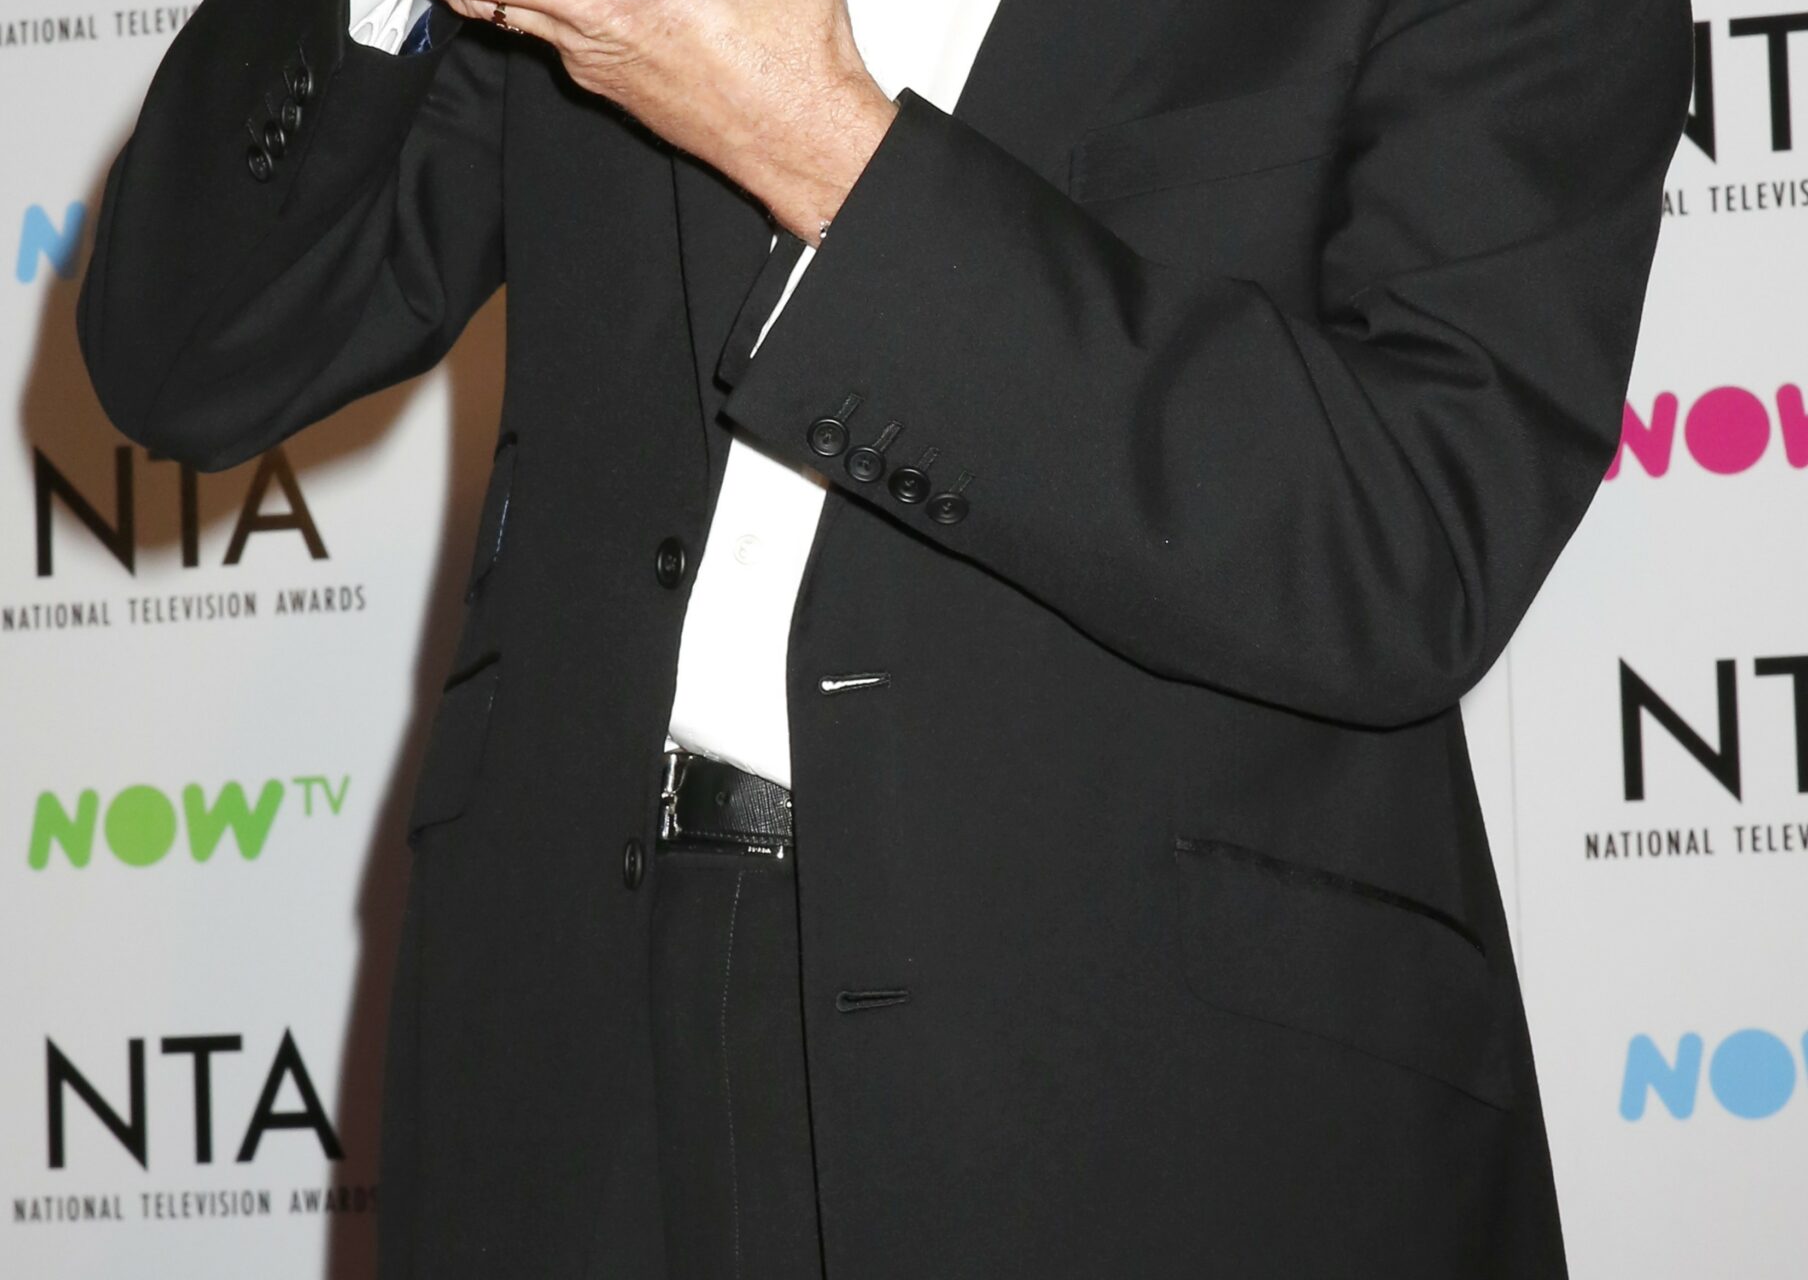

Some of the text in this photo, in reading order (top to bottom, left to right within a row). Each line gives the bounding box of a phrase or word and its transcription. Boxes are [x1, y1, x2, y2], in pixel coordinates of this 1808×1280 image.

[0, 5, 200, 47] ATIONAL TELEVI
[33, 444, 329, 578] NTA
[2, 584, 366, 631] NATIONAL TELEVISION AWARDS
[27, 775, 350, 871] NOW TV
[1585, 828, 1714, 860] NATIONAL
[45, 1025, 345, 1172] NTA
[1618, 1027, 1808, 1122] NO
[13, 1196, 123, 1222] NATIONAL
[141, 1190, 271, 1219] TELEVISION
